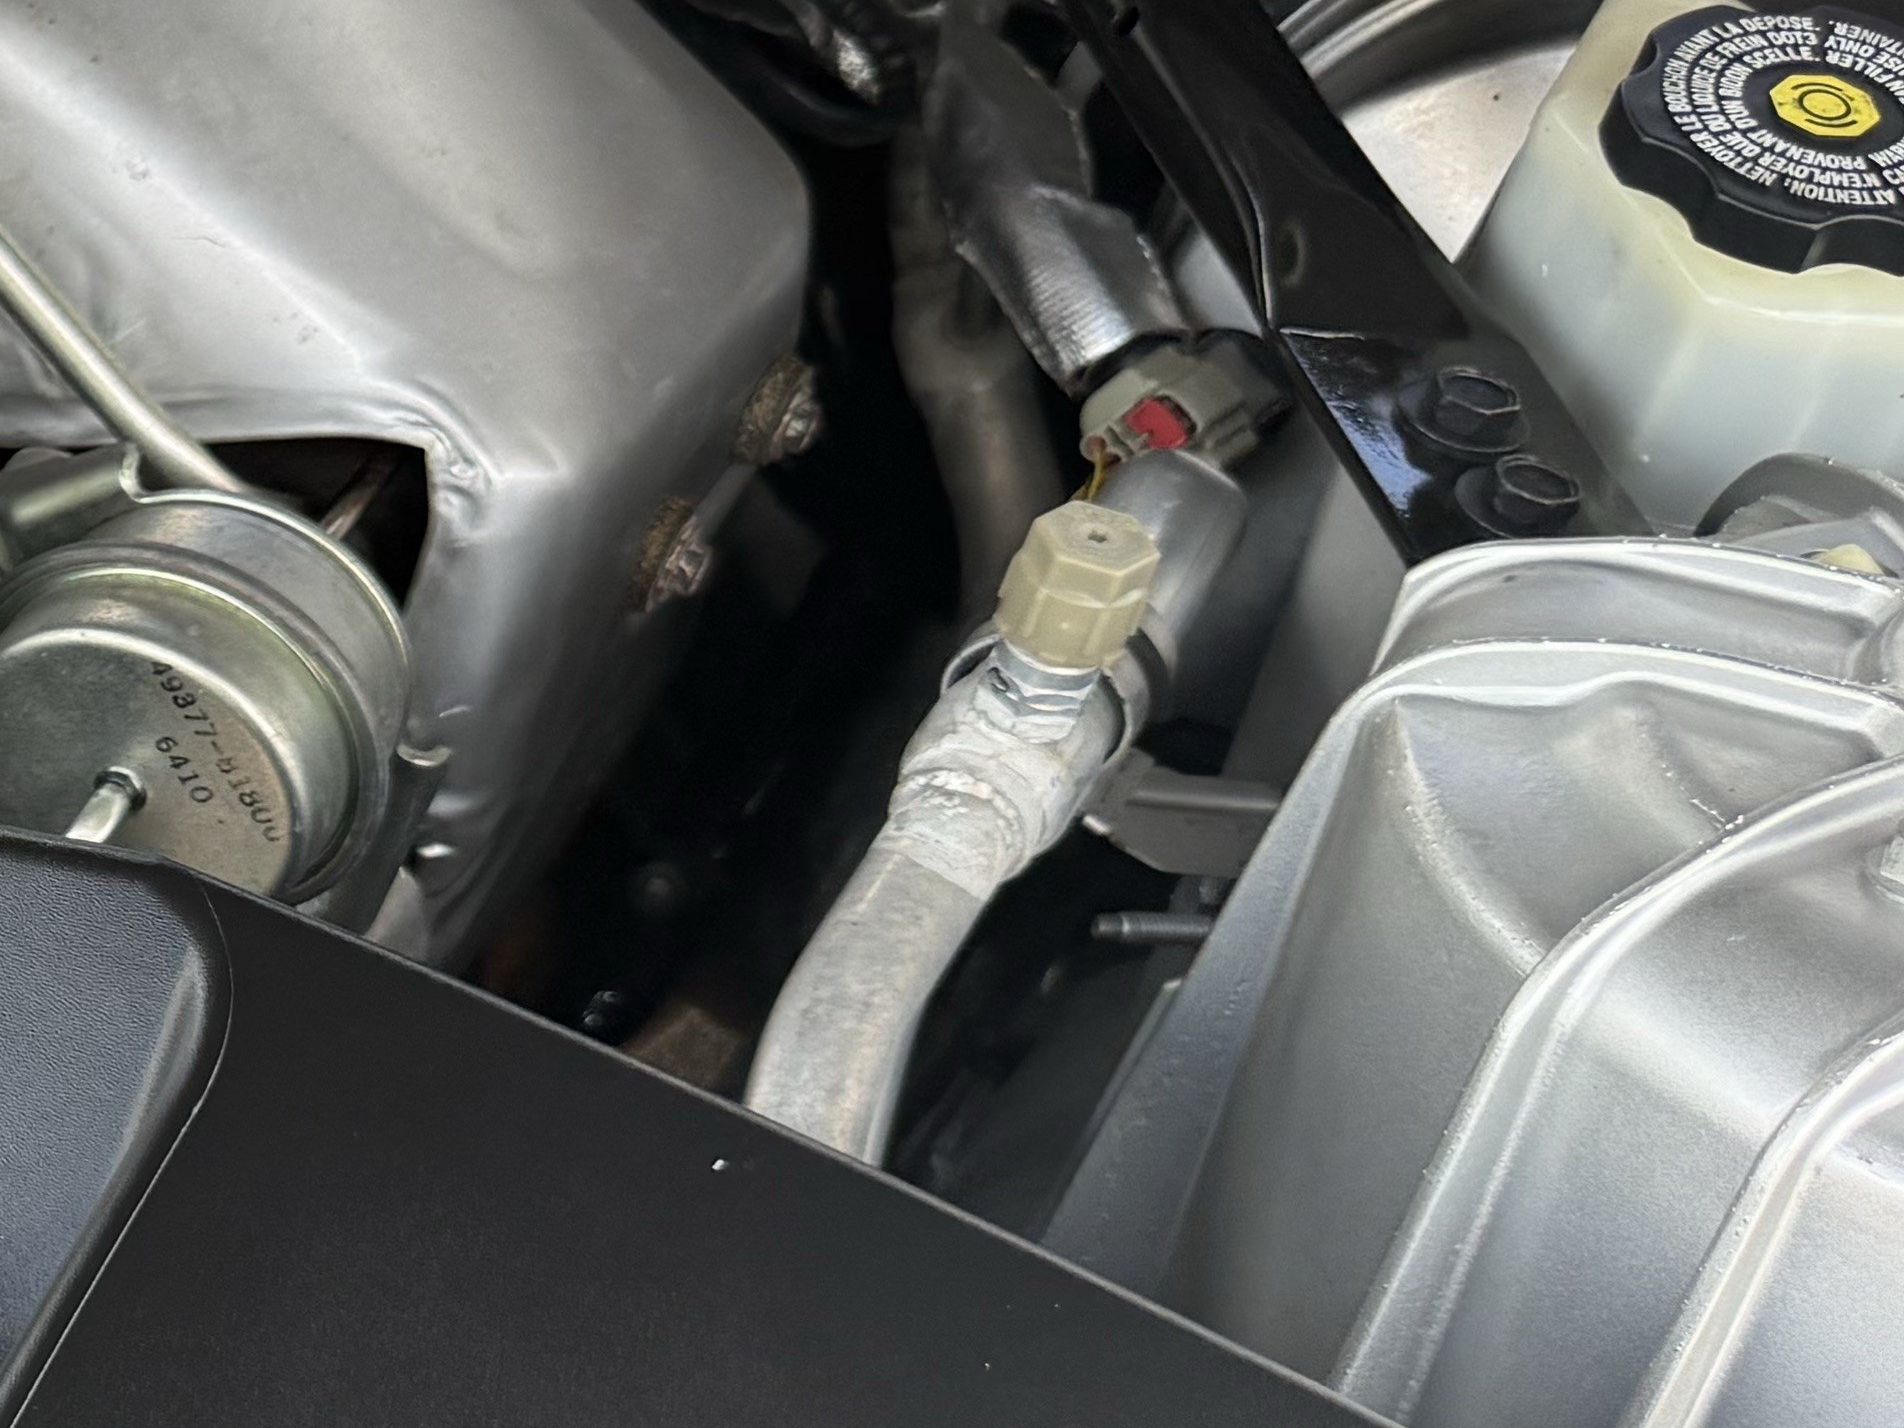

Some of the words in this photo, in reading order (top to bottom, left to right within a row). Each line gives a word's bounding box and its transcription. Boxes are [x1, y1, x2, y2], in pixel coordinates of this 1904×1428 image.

[1674, 28, 1719, 62] AVANT
[1712, 22, 1743, 39] LA
[1766, 30, 1818, 46] DOT3
[1715, 33, 1769, 59] FREIN
[1823, 35, 1875, 58] ONLY
[1699, 51, 1728, 71] DE
[1825, 50, 1895, 83] FILLER
[1662, 58, 1693, 113] BOUCHON
[1690, 66, 1720, 113] LIQUIDE
[1718, 62, 1754, 98] BIDON
[1674, 114, 1703, 131] LE
[1700, 113, 1733, 133] DU
[1690, 130, 1778, 187] NETTOYER
[1719, 130, 1762, 159] QUE
[1746, 128, 1868, 171] PROVENANT
[1783, 178, 1896, 205] ATTENTION:
[155, 736, 214, 804] 6410
